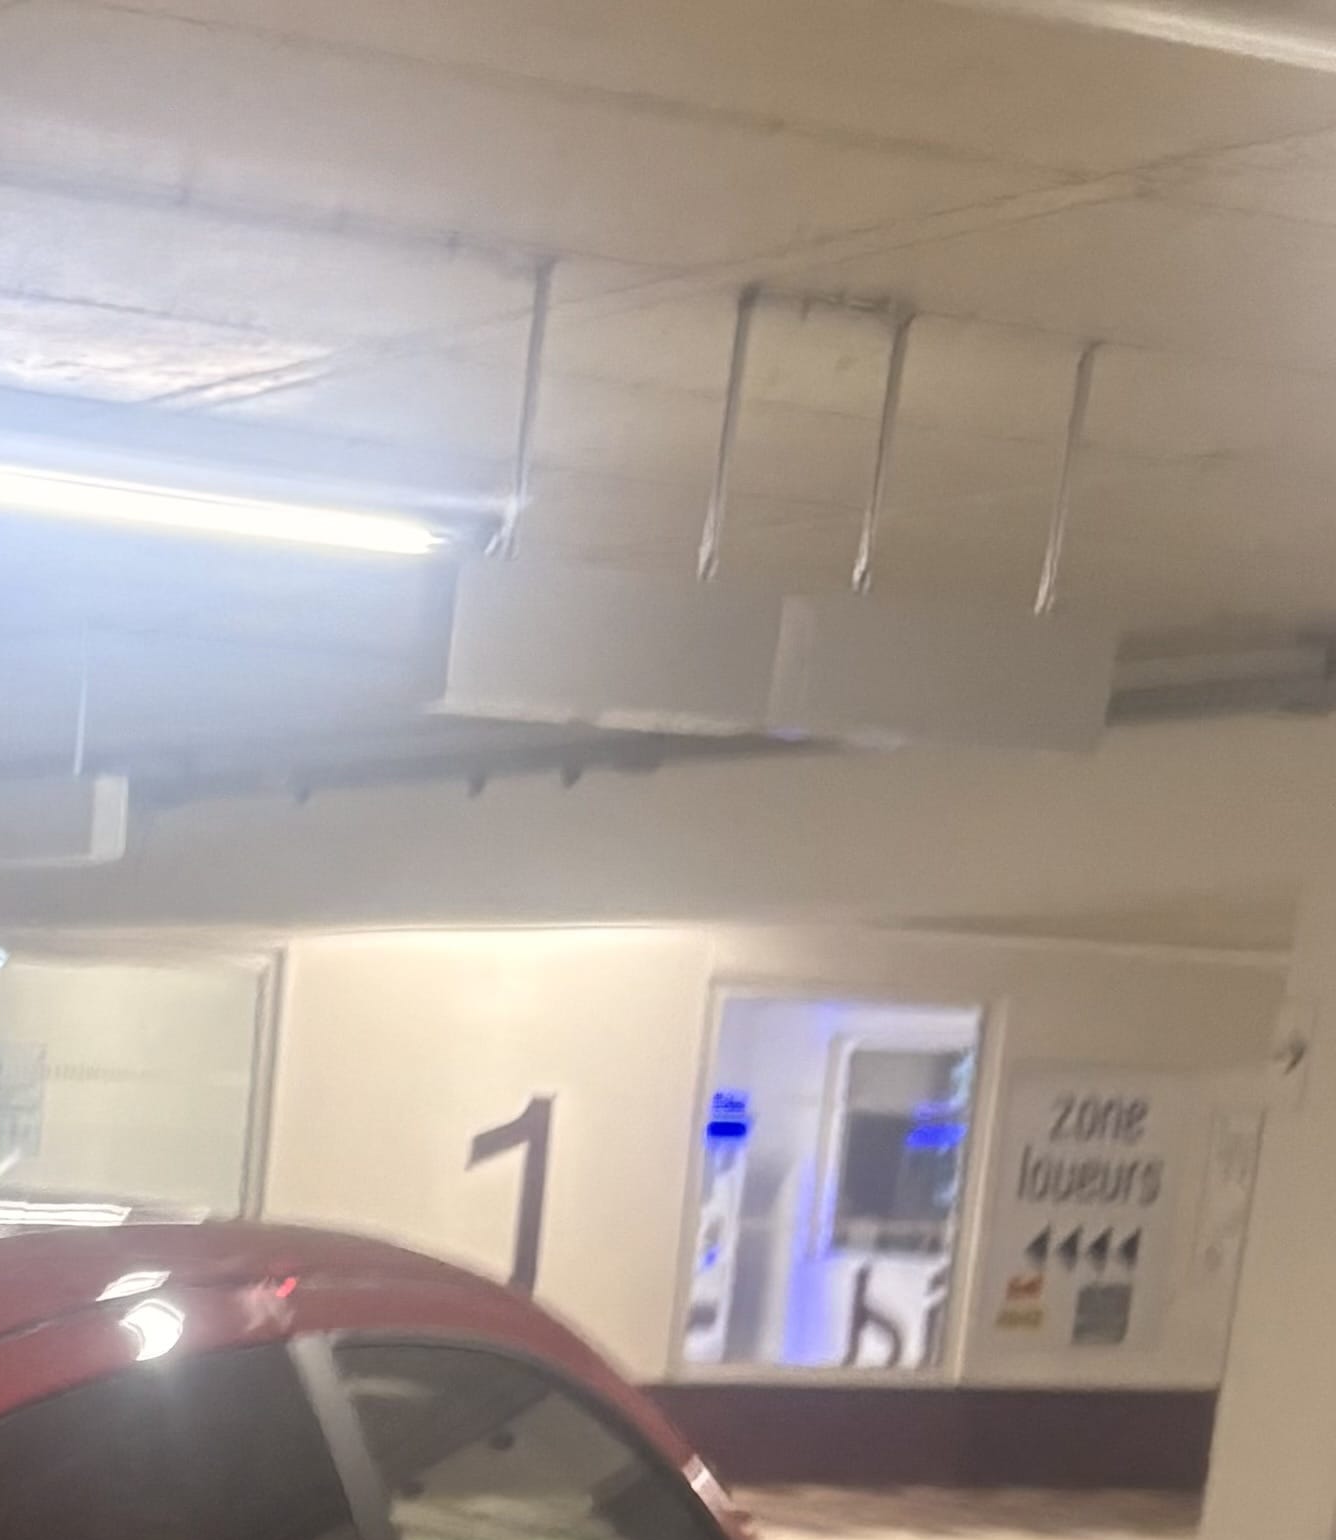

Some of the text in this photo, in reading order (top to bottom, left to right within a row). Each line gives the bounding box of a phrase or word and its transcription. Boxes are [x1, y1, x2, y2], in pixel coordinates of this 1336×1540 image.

[1049, 1095, 1149, 1144] zone
[465, 1094, 558, 1298] 1
[1016, 1145, 1164, 1206] loueurs
